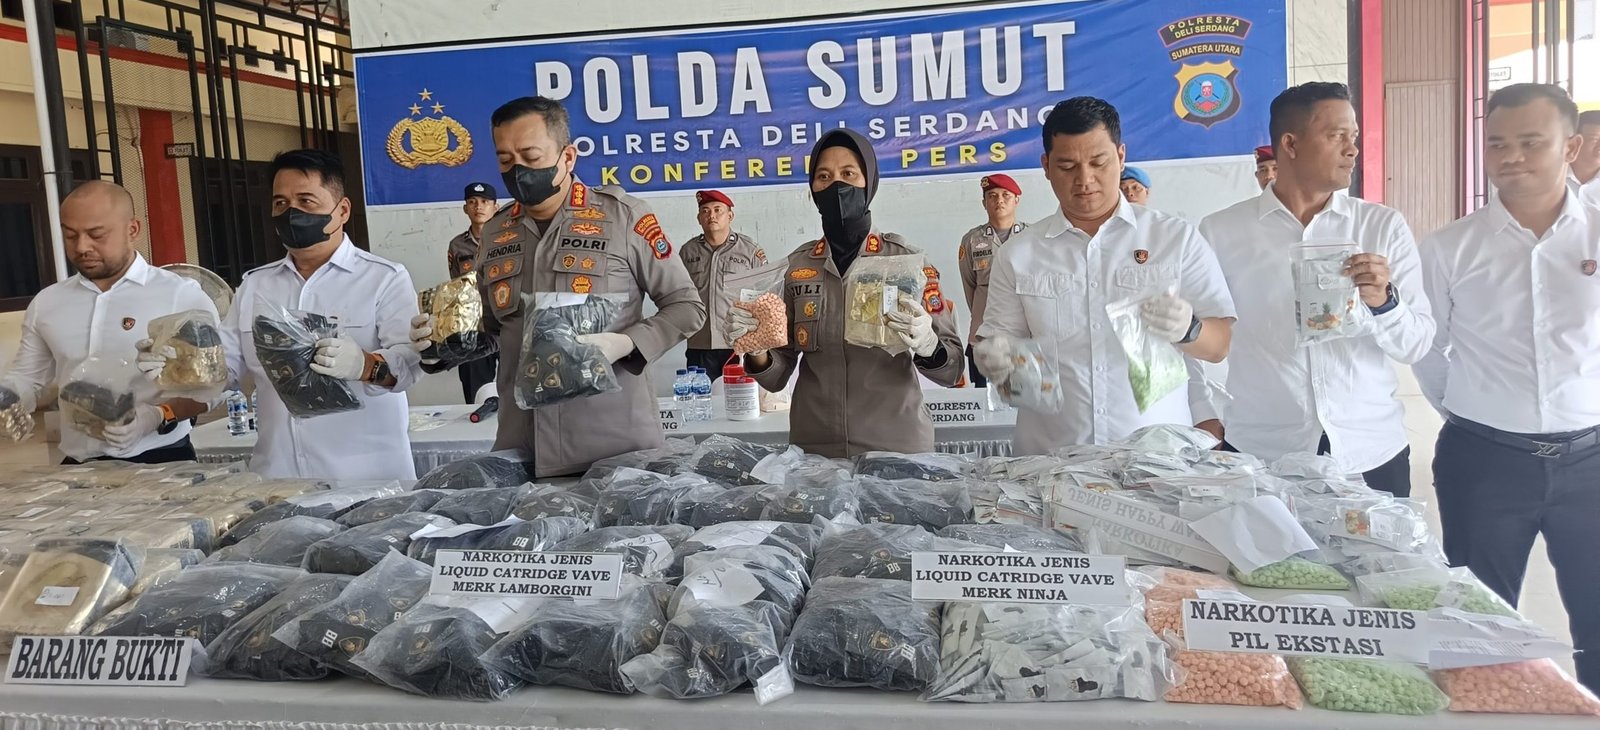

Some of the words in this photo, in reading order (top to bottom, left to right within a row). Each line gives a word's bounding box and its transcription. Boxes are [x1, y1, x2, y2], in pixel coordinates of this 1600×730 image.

[1169, 16, 1240, 32] POLRESTA
[1175, 28, 1194, 39] DELI
[1194, 25, 1235, 33] SERDANG
[1171, 44, 1213, 60] SUMATERA
[1215, 44, 1241, 54] UTARA
[535, 47, 772, 123] POLDA
[806, 21, 1075, 109] SUMUT
[573, 128, 741, 157] OLRESTA
[601, 155, 811, 186] KONFERE
[901, 142, 1007, 169] PERS
[486, 244, 521, 259] HENDRIA
[561, 238, 606, 250] POLRI
[462, 552, 546, 564] NARKOTIKA
[551, 555, 593, 565] JENIS
[938, 554, 1036, 568] NARKOTIKA
[1041, 557, 1090, 569] JENIS
[440, 566, 489, 578] LIQUID
[493, 568, 568, 580] CATRIDGE
[572, 570, 611, 581] VAVE
[915, 570, 972, 583] LIQUID
[977, 571, 1064, 584] CATRIDGE
[1069, 573, 1115, 586] VAVE
[452, 581, 495, 593] MERK
[499, 583, 592, 596] LAMBORGINI
[962, 587, 1012, 599] MERK
[1016, 588, 1068, 600] NINJA
[1190, 601, 1336, 626] NARKOTIKA
[1342, 609, 1415, 629] JENIS
[1229, 631, 1269, 649] PIL
[1275, 634, 1384, 656] EKSTASI
[12, 638, 107, 680] BARANG
[108, 638, 185, 681] BUKTI
